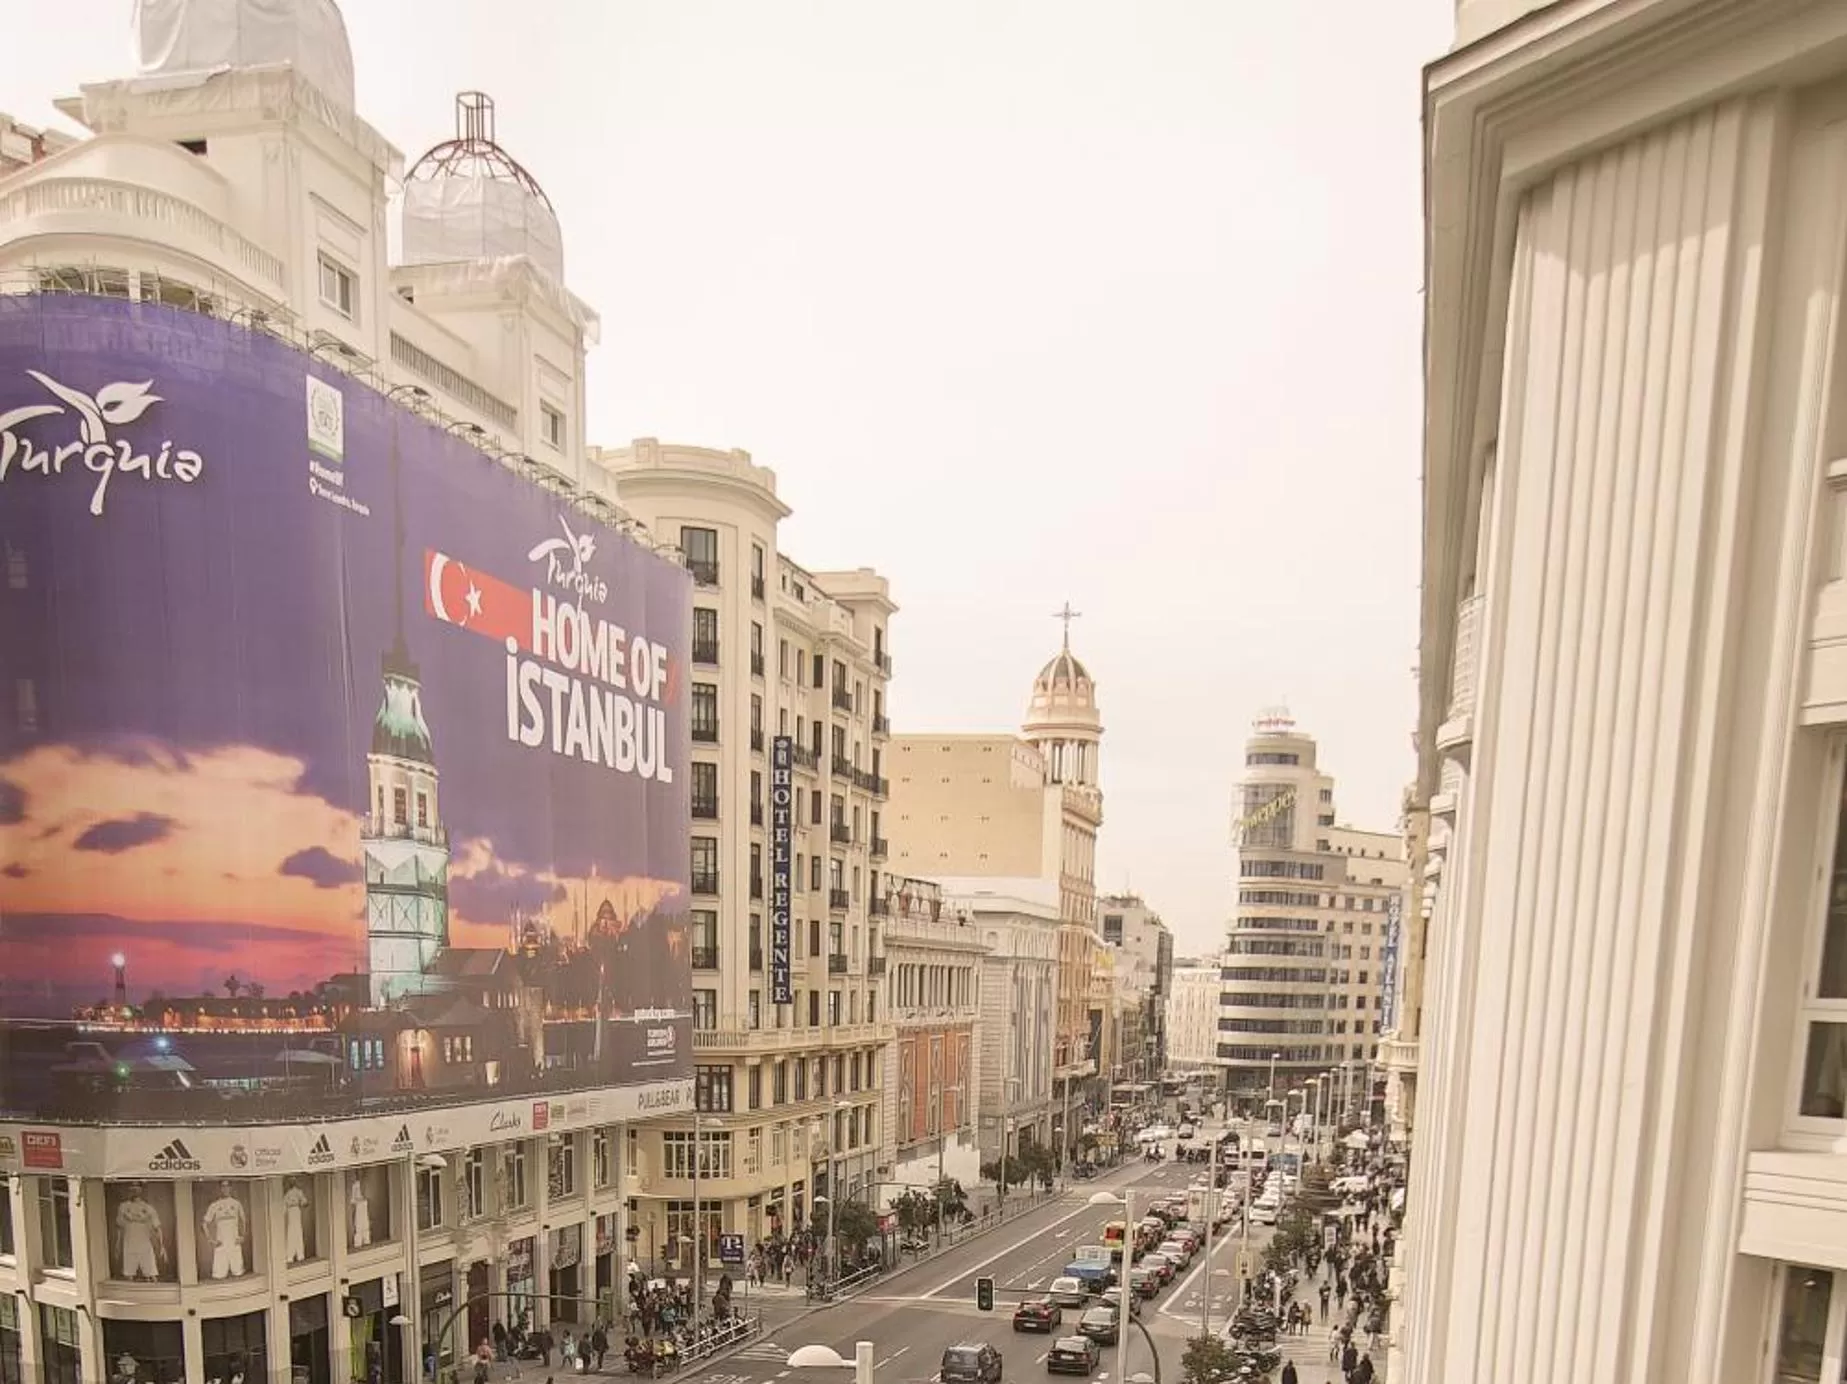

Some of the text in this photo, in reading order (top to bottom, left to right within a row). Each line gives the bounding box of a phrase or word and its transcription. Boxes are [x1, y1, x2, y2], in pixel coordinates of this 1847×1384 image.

[532, 588, 668, 702] HOME OF
[773, 768, 789, 1002] HOTEL REGENTE
[149, 1156, 201, 1172] adidas
[308, 1152, 335, 1165] adidas
